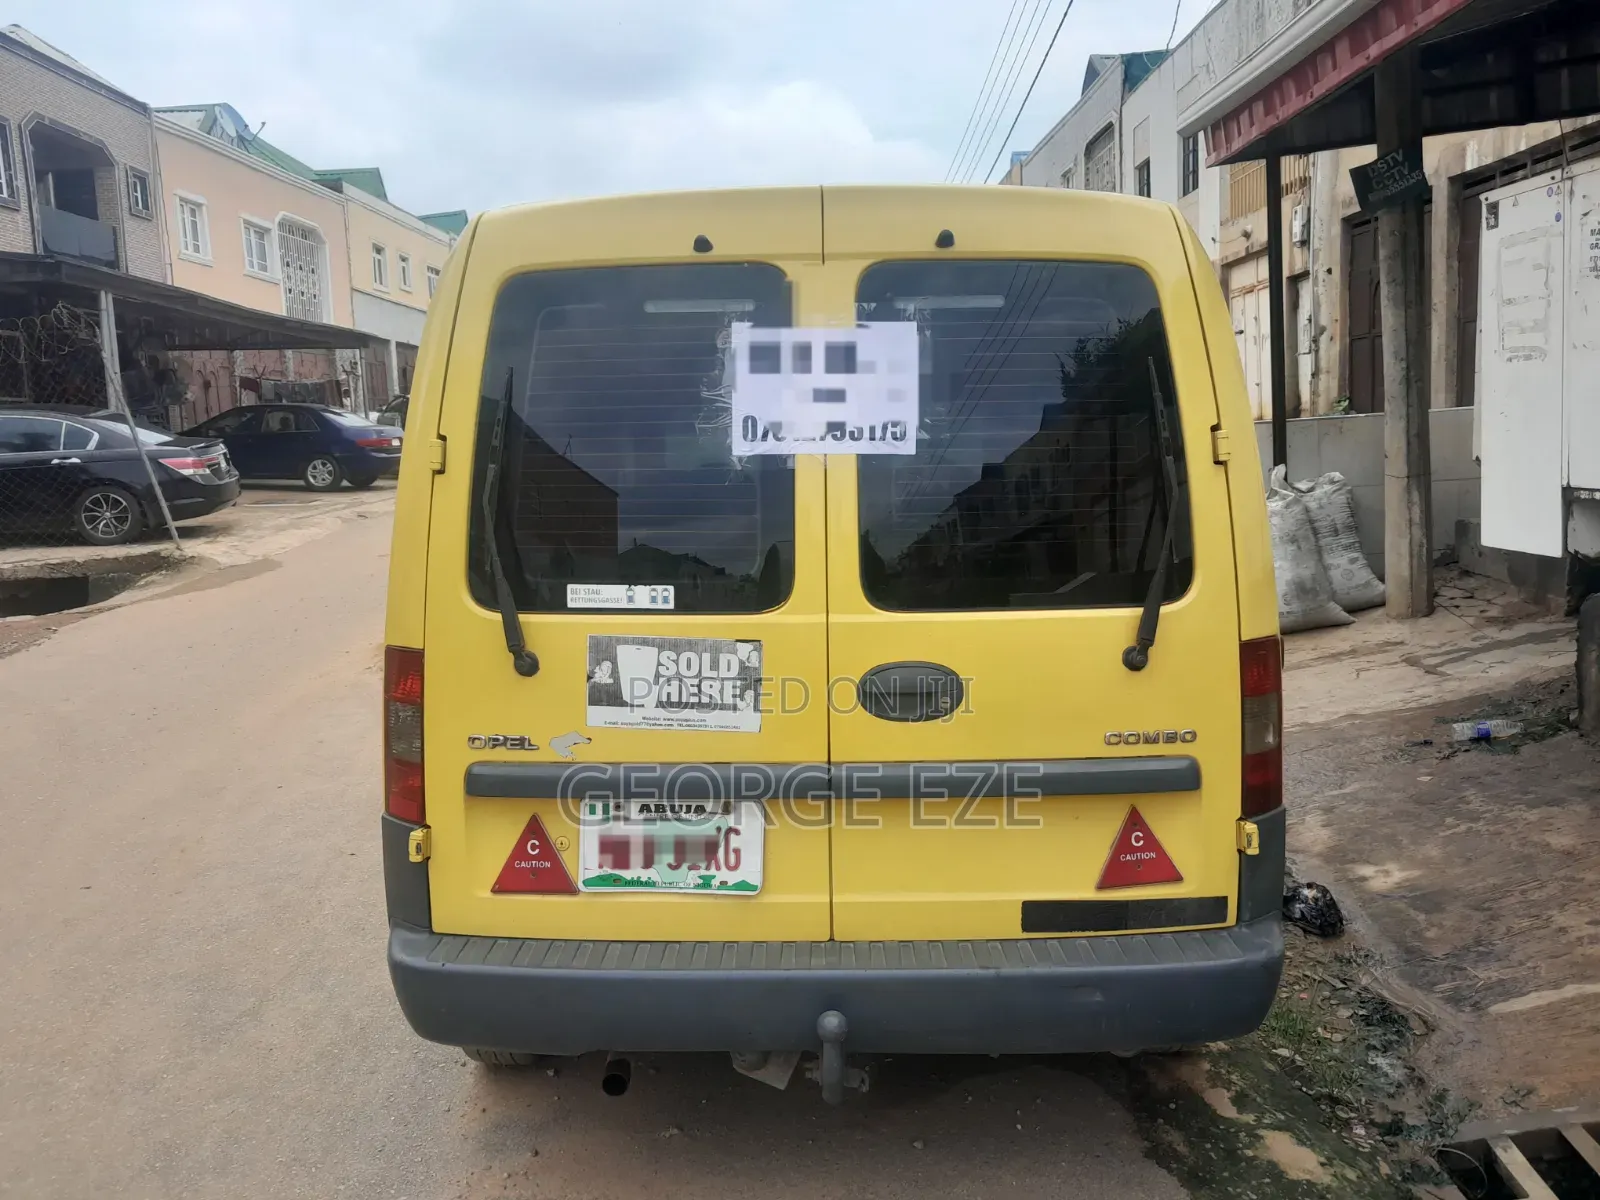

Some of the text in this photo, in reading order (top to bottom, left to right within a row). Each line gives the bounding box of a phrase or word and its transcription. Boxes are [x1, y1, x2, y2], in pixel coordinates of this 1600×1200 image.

[1367, 148, 1403, 177] DSTV
[1372, 161, 1408, 189] CCTV
[570, 587, 581, 596] BEI
[570, 596, 623, 604] RETTUNGSGASSE!
[658, 650, 740, 678] SOLD
[658, 677, 742, 704] HERE
[467, 734, 540, 750] OPEL
[1104, 729, 1198, 746] COMBO
[638, 803, 707, 815] ABUJA
[527, 839, 540, 855] C
[1131, 831, 1144, 847] C
[514, 860, 551, 868] CAUTION
[1120, 851, 1156, 861] CAUTION
